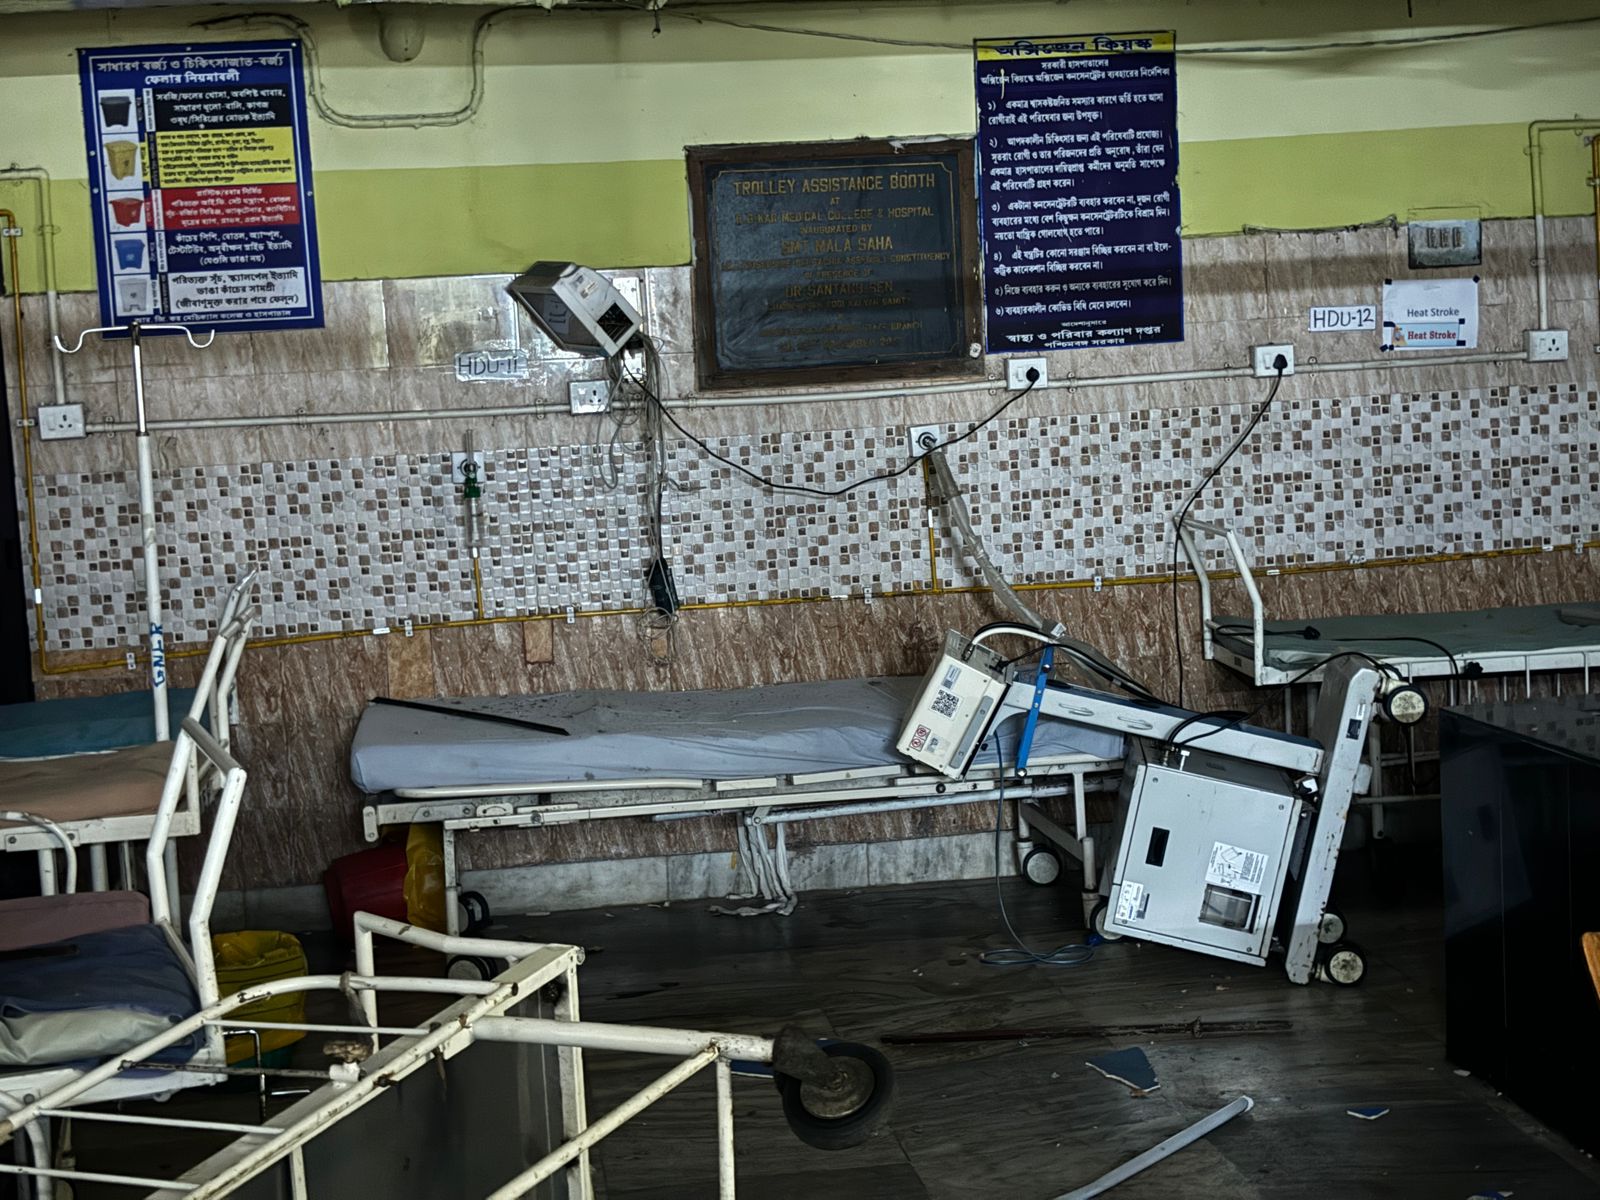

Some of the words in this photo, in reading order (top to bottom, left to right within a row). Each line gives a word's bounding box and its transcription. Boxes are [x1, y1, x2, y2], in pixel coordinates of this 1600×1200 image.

[1040, 59, 1066, 69] সরকারী
[1068, 59, 1108, 68] হাসপাতালের
[144, 74, 182, 84] ফেলার
[184, 69, 240, 82] নিয়মাবলী
[734, 180, 796, 195] TROLLEY
[803, 176, 883, 192] ASSISTANCE
[890, 174, 935, 189] BOOTH
[830, 197, 840, 205] AT
[781, 211, 822, 223] MEDICAL
[888, 206, 934, 217] HOSPITAL
[801, 225, 857, 234] INAUGURATED
[861, 224, 872, 232] BY
[815, 238, 851, 253] MALA
[858, 236, 893, 250] SAHA
[1314, 308, 1373, 328] HDU-12
[1407, 309, 1428, 317] Heat
[1431, 307, 1459, 316] Stroke
[1006, 334, 1033, 342] স্বাস্থ্য
[1051, 329, 1092, 341] পরিবার
[1096, 328, 1131, 337] কল্যাণ
[1135, 326, 1161, 335] দপ্তর
[1408, 331, 1427, 340] Heat
[1429, 330, 1456, 339] Stroke
